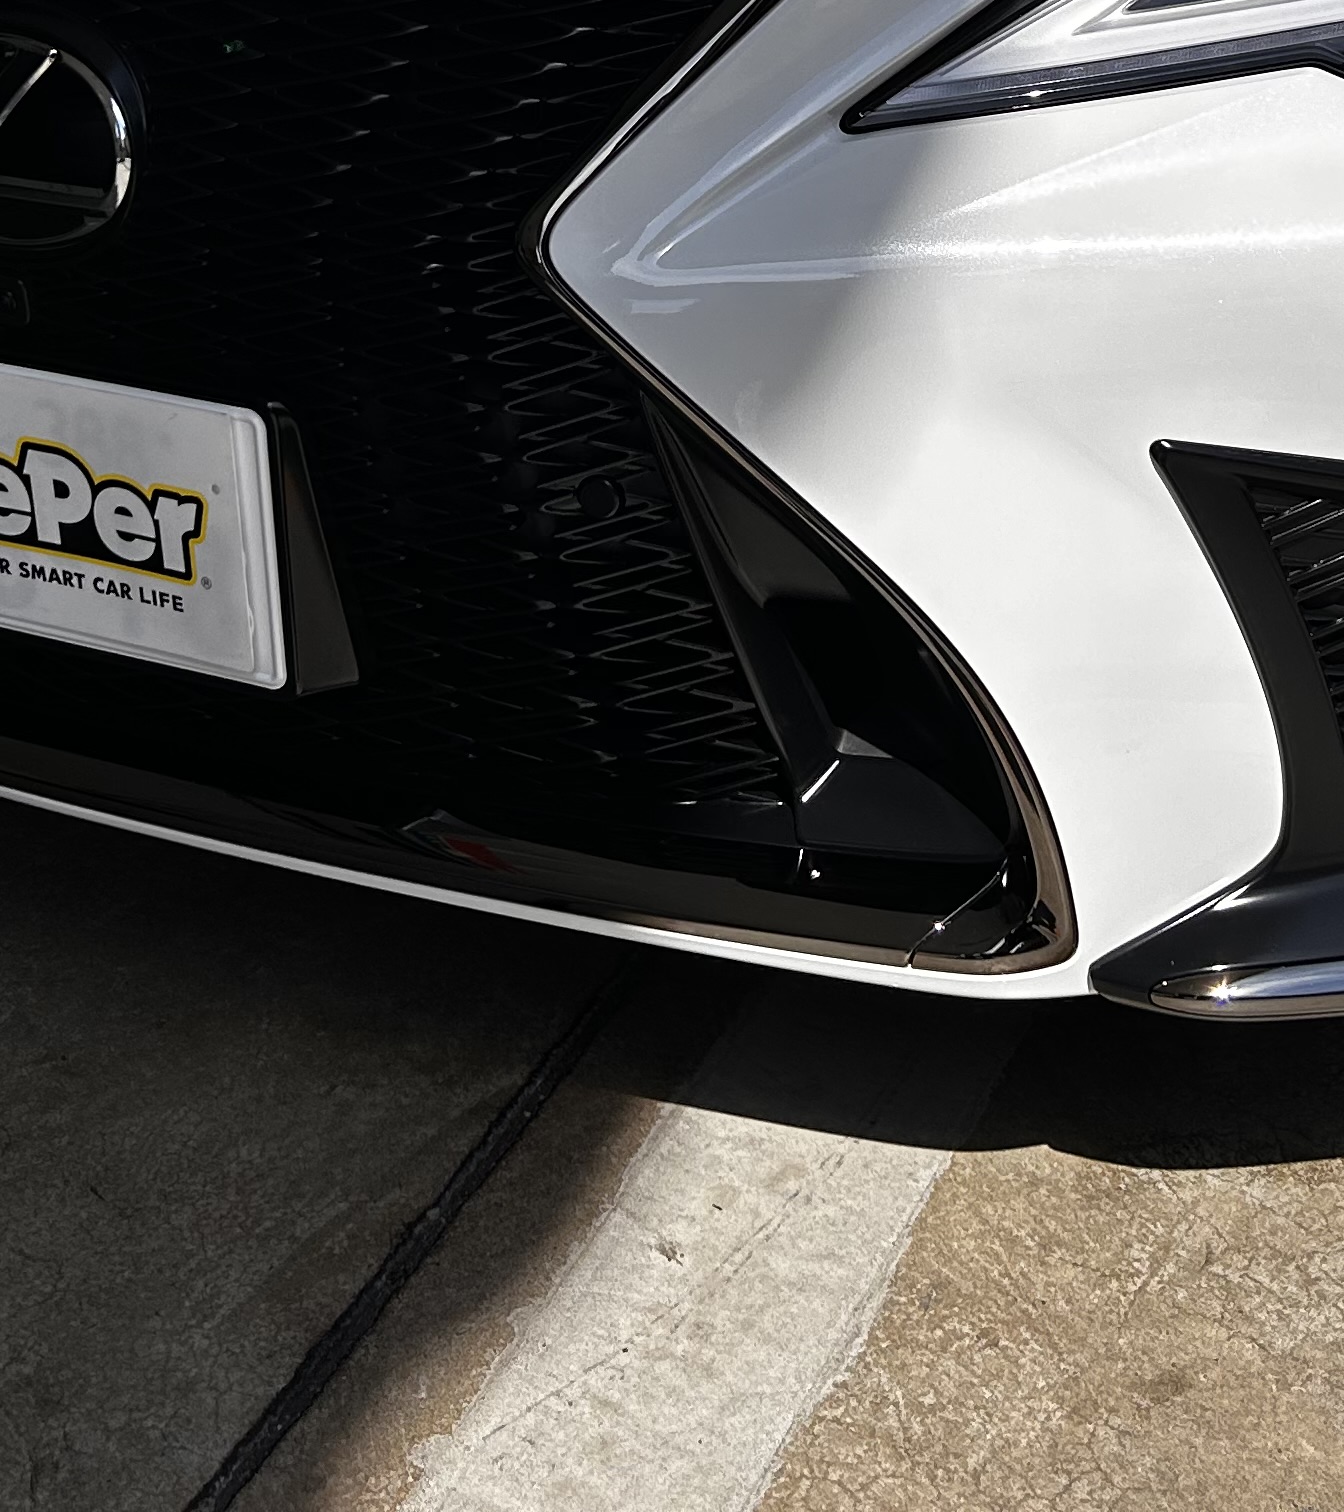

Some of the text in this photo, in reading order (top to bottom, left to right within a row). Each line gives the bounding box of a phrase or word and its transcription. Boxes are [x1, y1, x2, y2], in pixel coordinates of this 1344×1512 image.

[19, 562, 85, 589] SMART
[92, 577, 133, 601] CAR
[139, 587, 185, 612] LIFE
